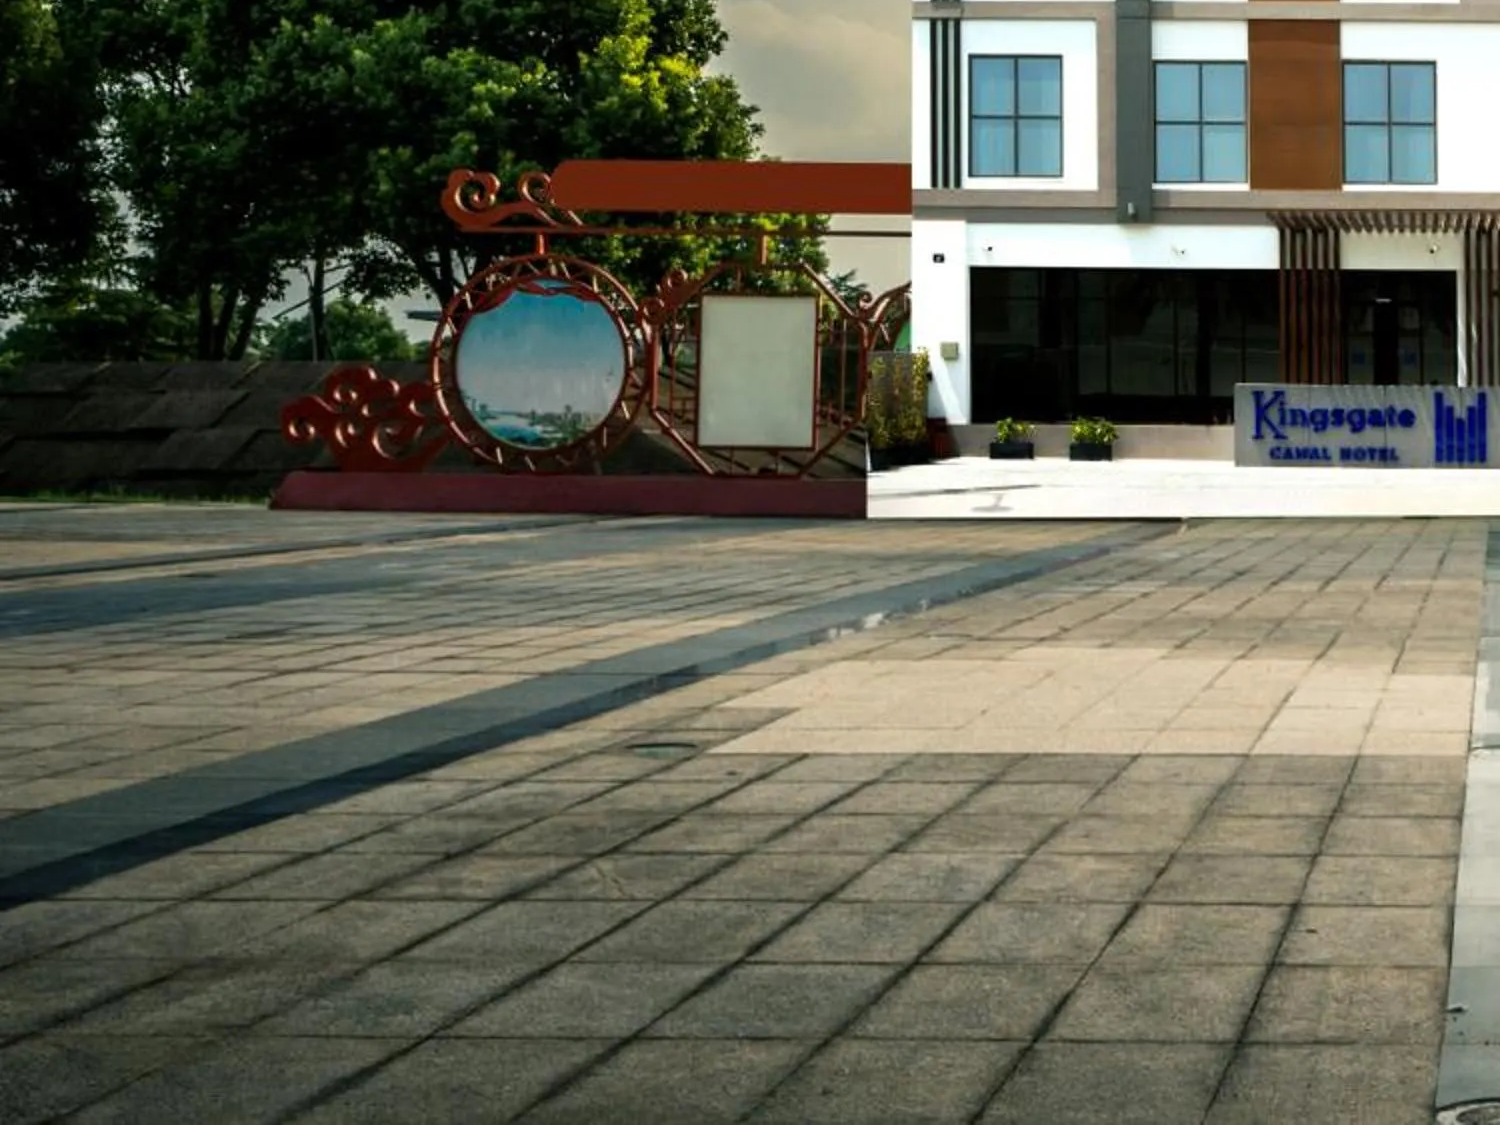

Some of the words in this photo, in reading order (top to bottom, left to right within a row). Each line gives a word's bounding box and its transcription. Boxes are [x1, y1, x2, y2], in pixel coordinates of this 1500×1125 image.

[1251, 389, 1417, 442] Kingsgate
[1269, 446, 1332, 461] CANAL
[1339, 446, 1399, 462] HOTEL
